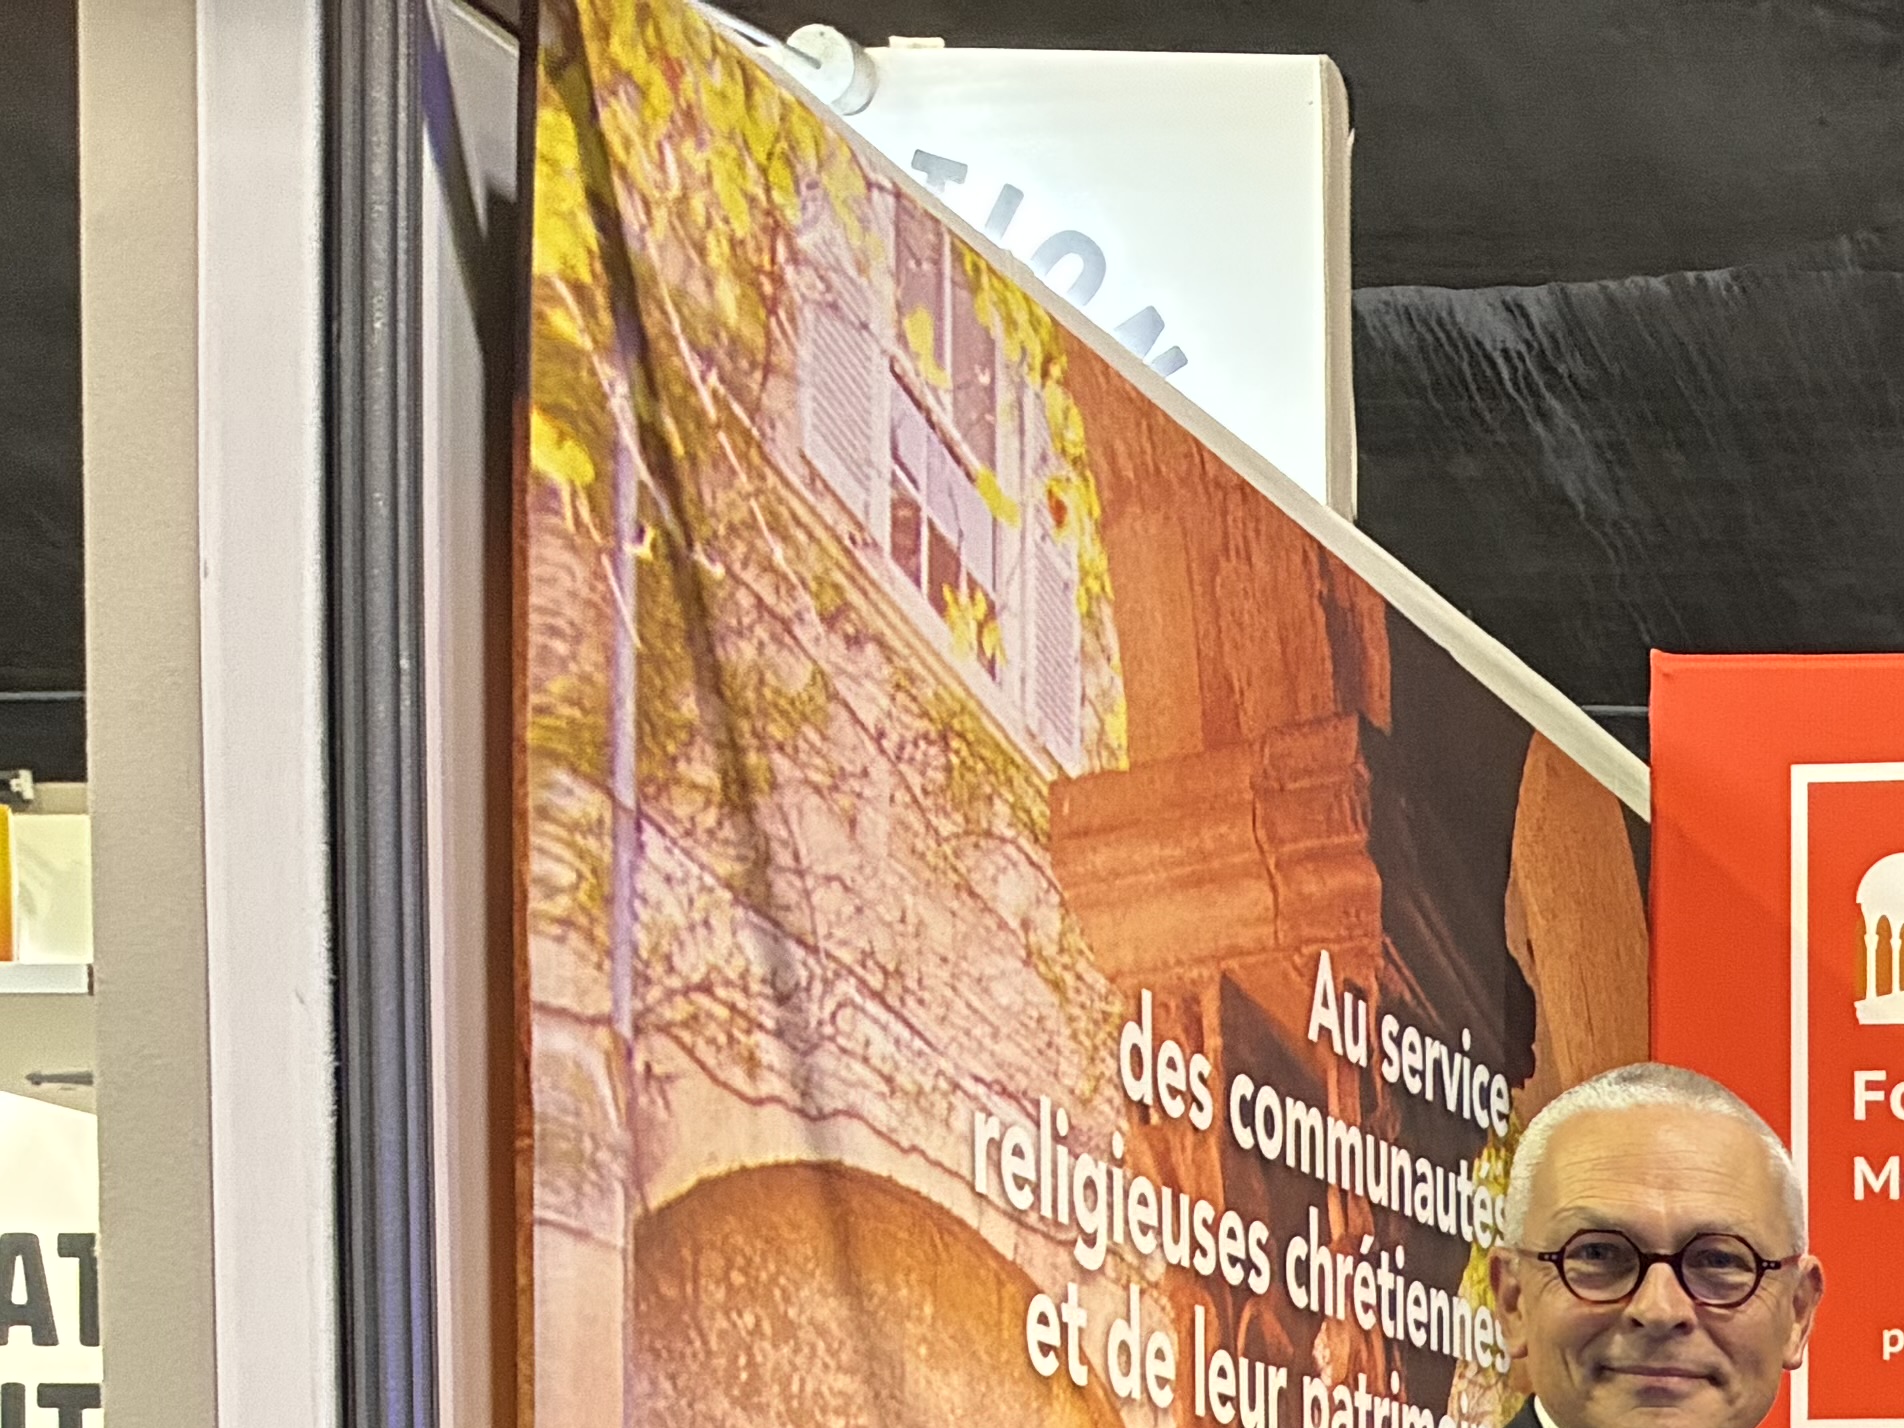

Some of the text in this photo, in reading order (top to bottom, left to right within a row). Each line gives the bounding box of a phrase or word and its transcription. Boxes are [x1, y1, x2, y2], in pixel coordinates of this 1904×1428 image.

[1119, 990, 1506, 1249] des communautés
[1307, 949, 1511, 1138] Au service
[971, 1096, 1512, 1375] religieuses chrétiennes
[1026, 1282, 1089, 1388] et
[1107, 1285, 1176, 1410] de
